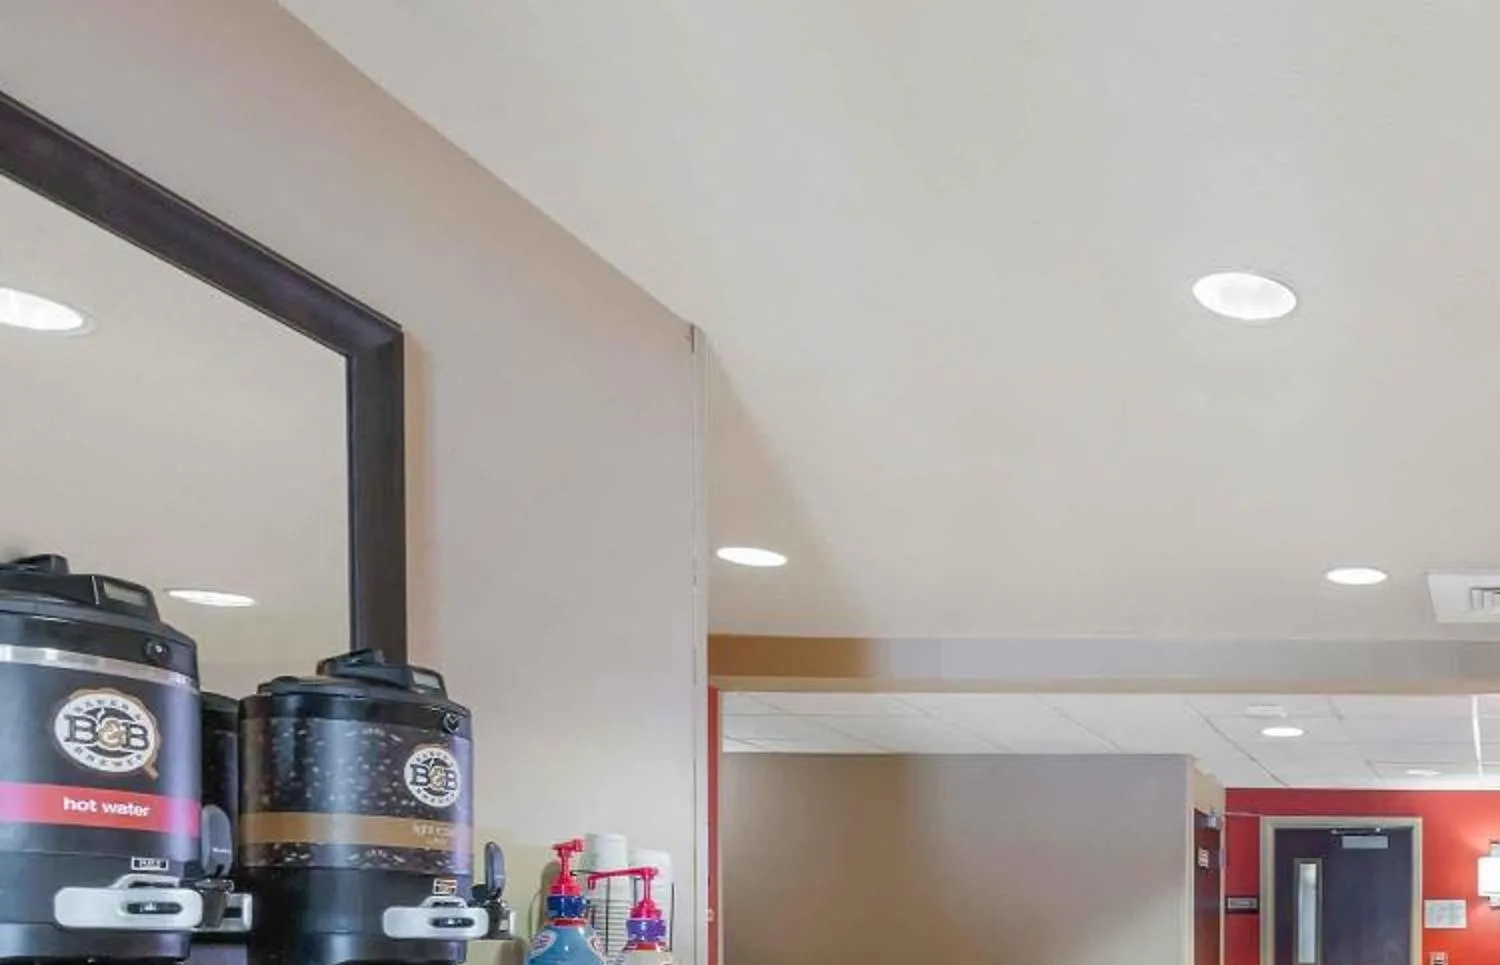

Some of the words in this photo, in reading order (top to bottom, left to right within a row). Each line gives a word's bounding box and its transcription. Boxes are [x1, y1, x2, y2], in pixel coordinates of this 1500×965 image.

[62, 713, 151, 751] B&B
[63, 796, 98, 813] hot
[101, 801, 152, 817] water
